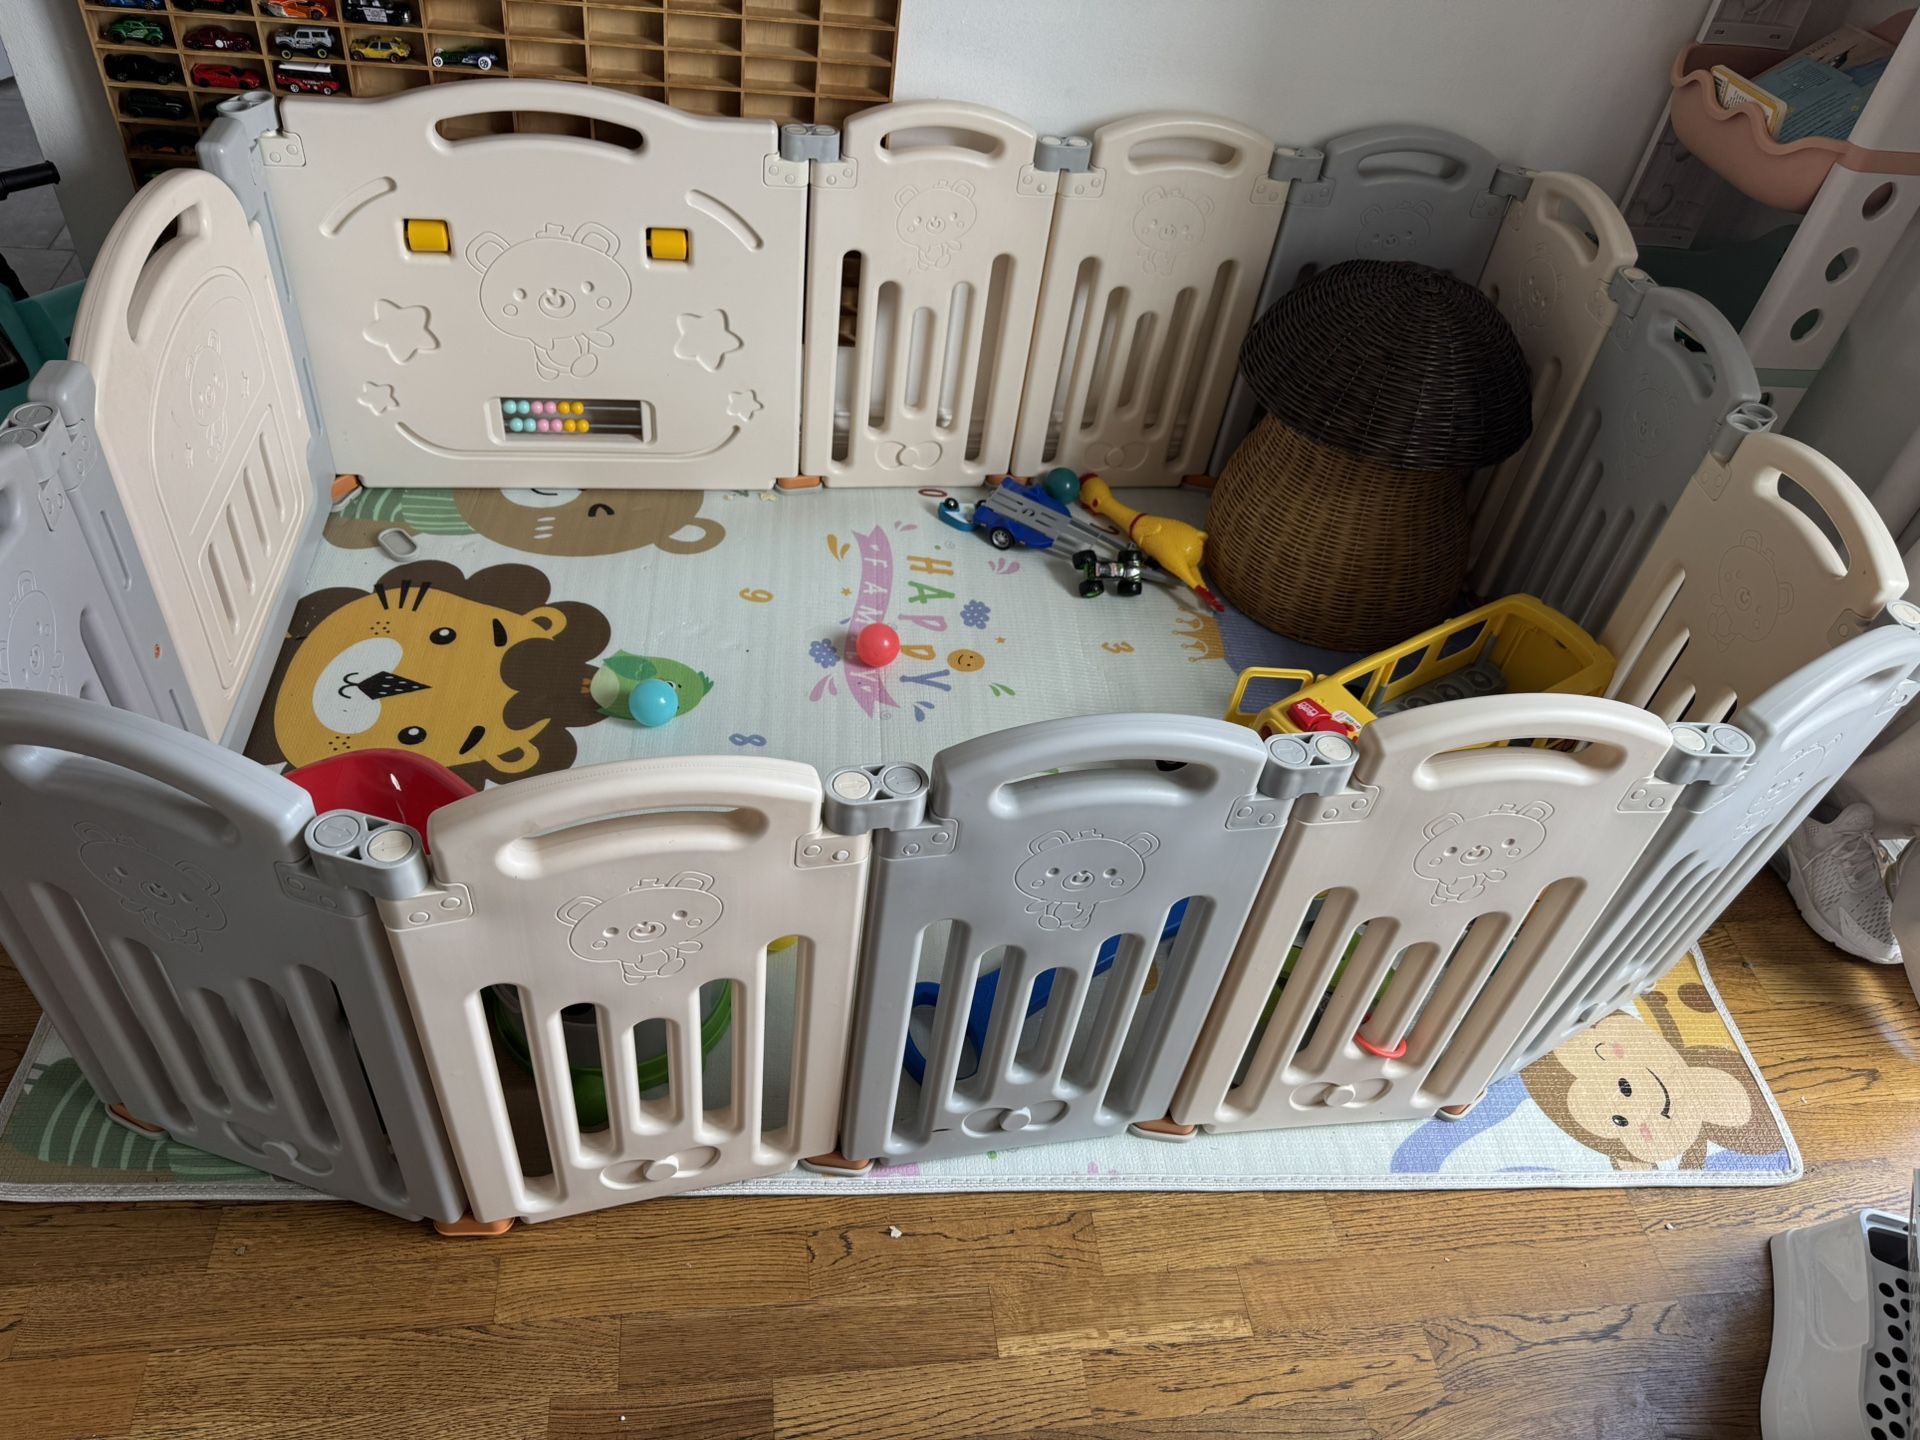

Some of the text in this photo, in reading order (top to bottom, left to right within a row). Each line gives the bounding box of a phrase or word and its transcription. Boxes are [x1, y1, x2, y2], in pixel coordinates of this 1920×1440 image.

[847, 557, 888, 683] FAMY
[898, 554, 956, 692] HAPPY
[1101, 641, 1136, 654] 3
[728, 733, 768, 747] 8
